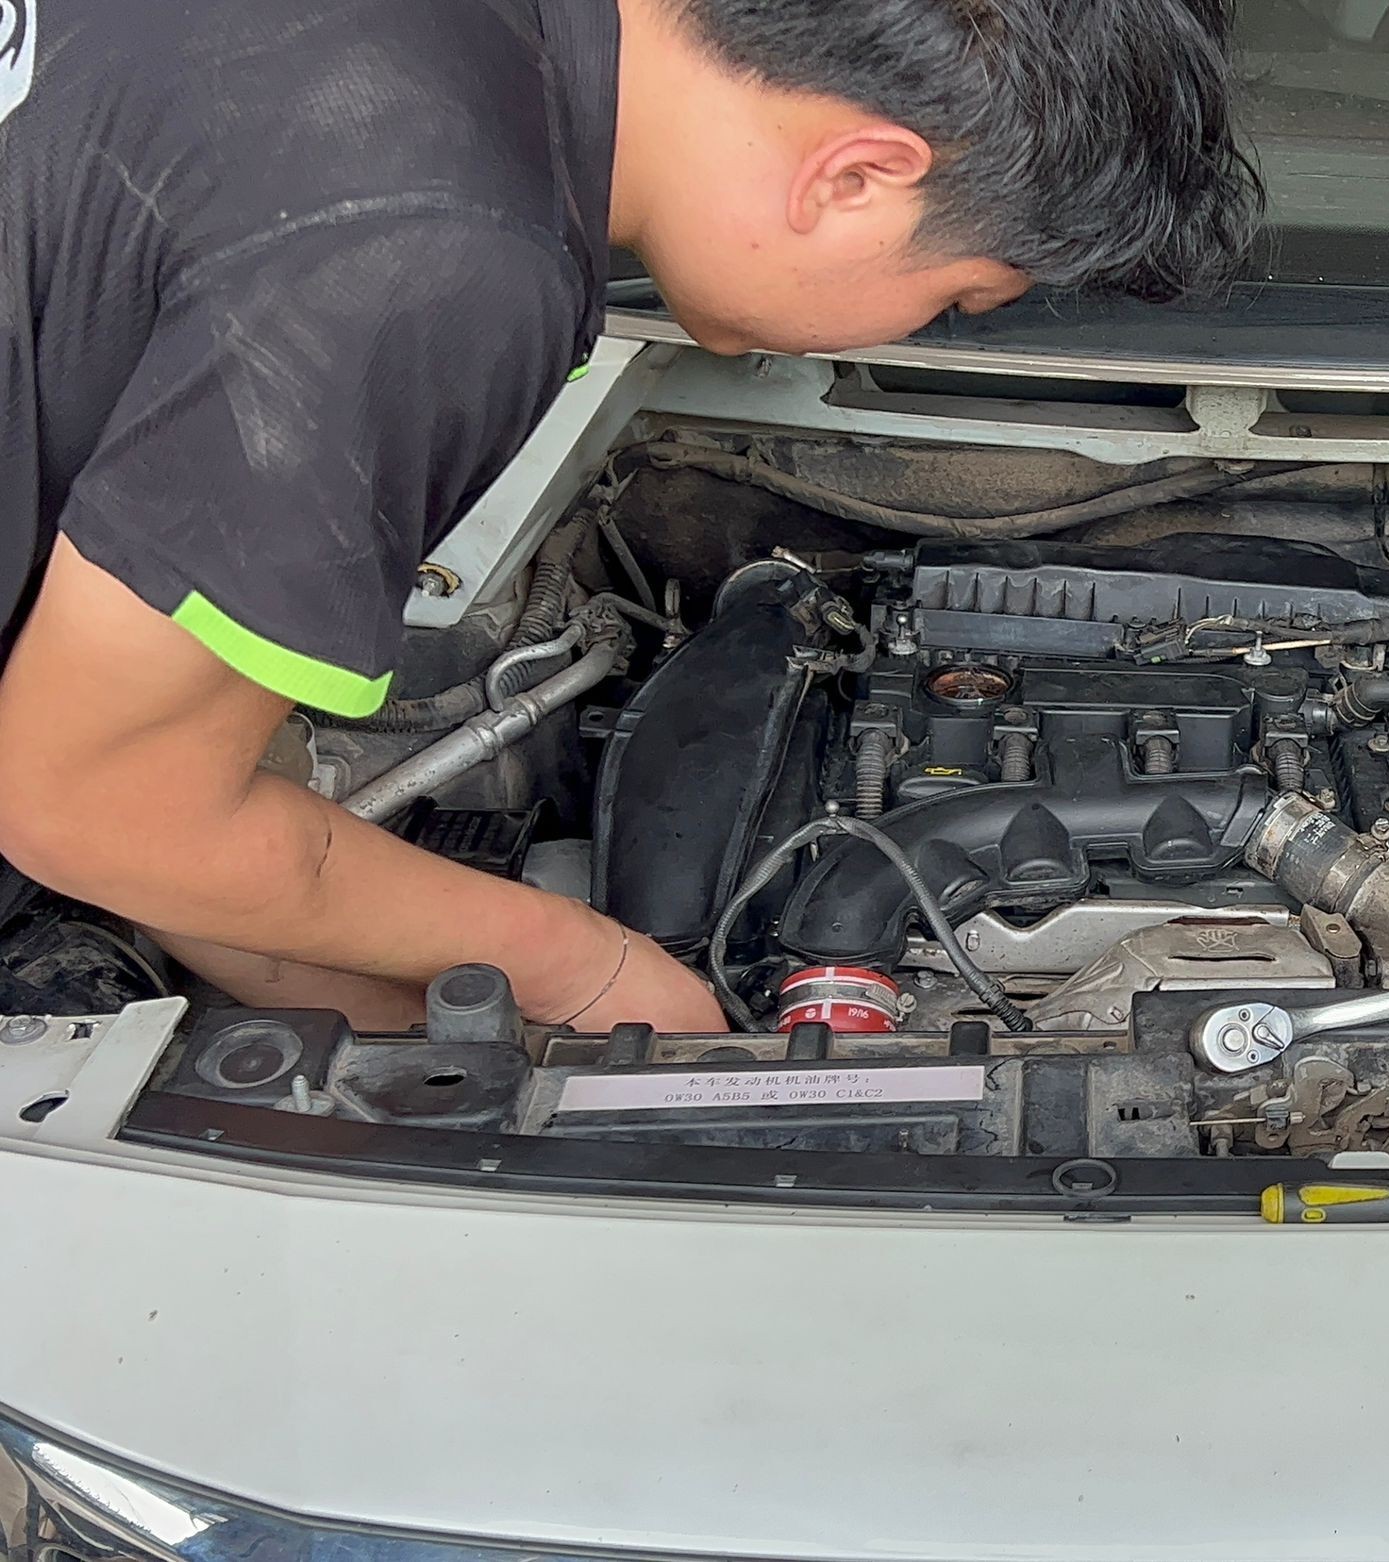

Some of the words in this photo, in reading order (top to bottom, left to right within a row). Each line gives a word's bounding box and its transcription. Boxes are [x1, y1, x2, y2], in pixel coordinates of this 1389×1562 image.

[665, 1092, 703, 1103] 0W30
[712, 1091, 751, 1102] A5B5
[761, 1089, 779, 1100] 或
[789, 1089, 827, 1100] 0W30
[836, 1088, 883, 1099] C1&C2
